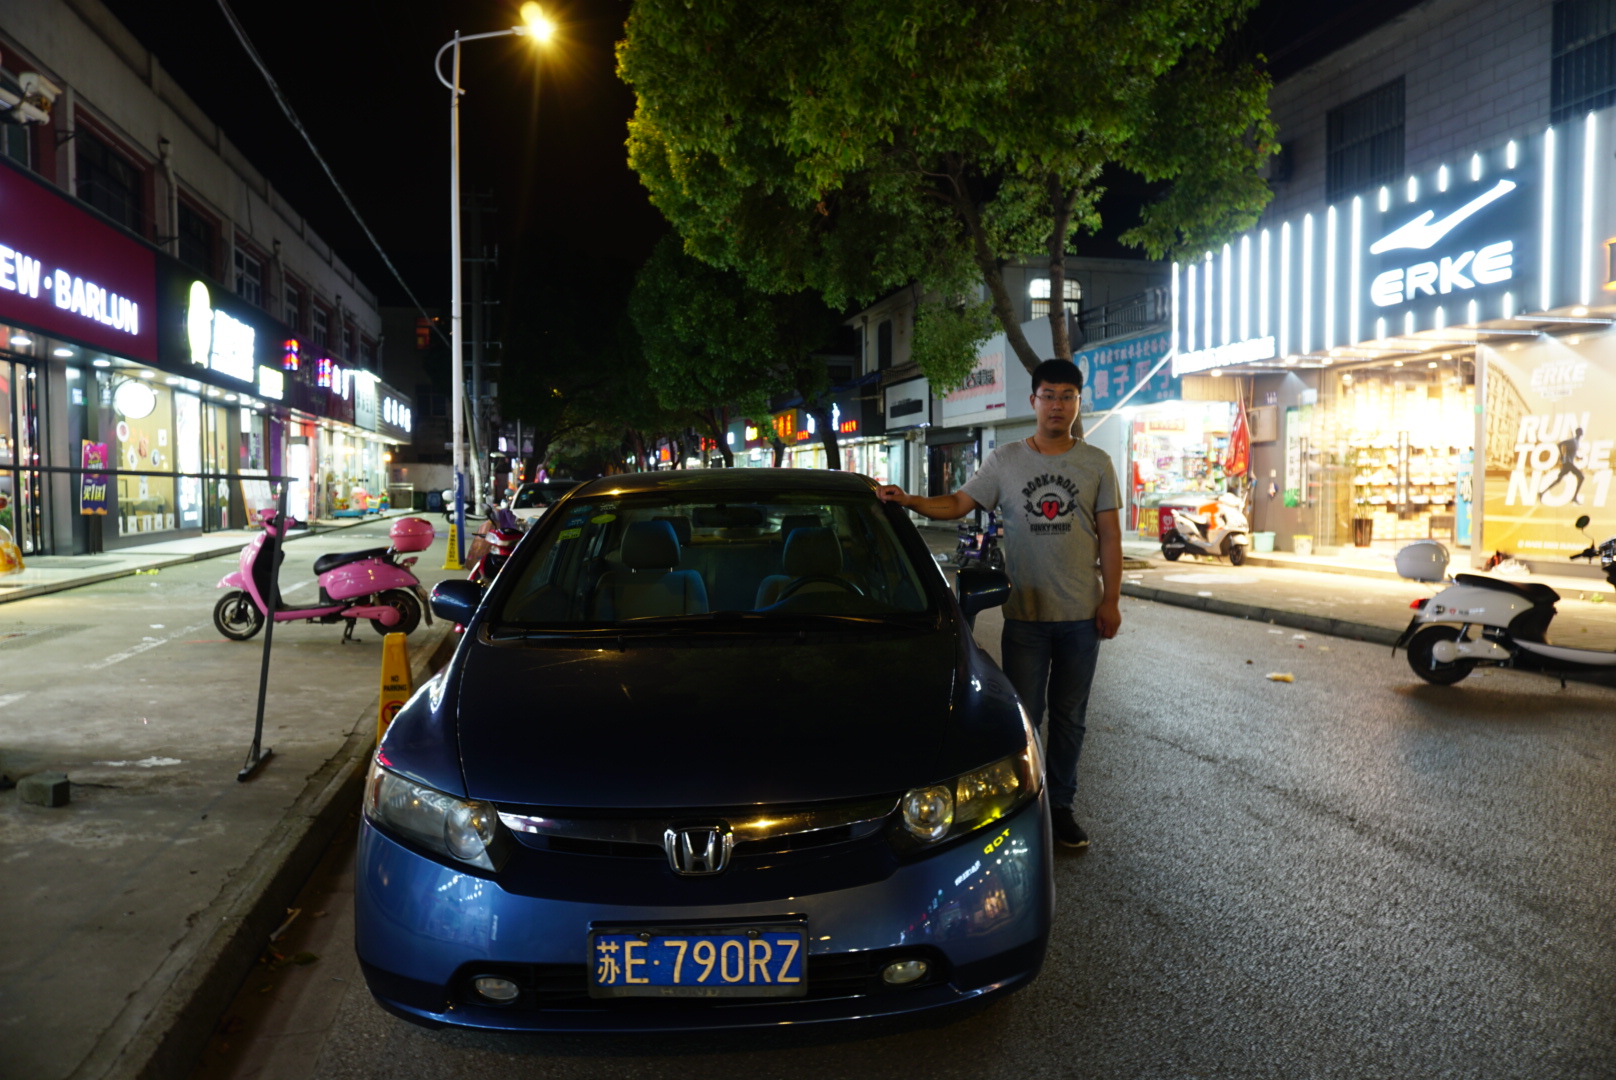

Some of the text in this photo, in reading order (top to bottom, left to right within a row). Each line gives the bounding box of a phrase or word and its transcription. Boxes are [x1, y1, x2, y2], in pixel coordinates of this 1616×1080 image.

[1371, 240, 1513, 307] ERKE
[1530, 362, 1587, 387] ERKE
[1517, 411, 1590, 443] RUN
[1514, 442, 1560, 471] TO
[1505, 469, 1613, 507] NO.1
[1052, 522, 1072, 532] MUSIC
[383, 683, 407, 692] PARKING
[390, 675, 399, 683] NO
[597, 939, 800, 984] 苏E·790RZ
